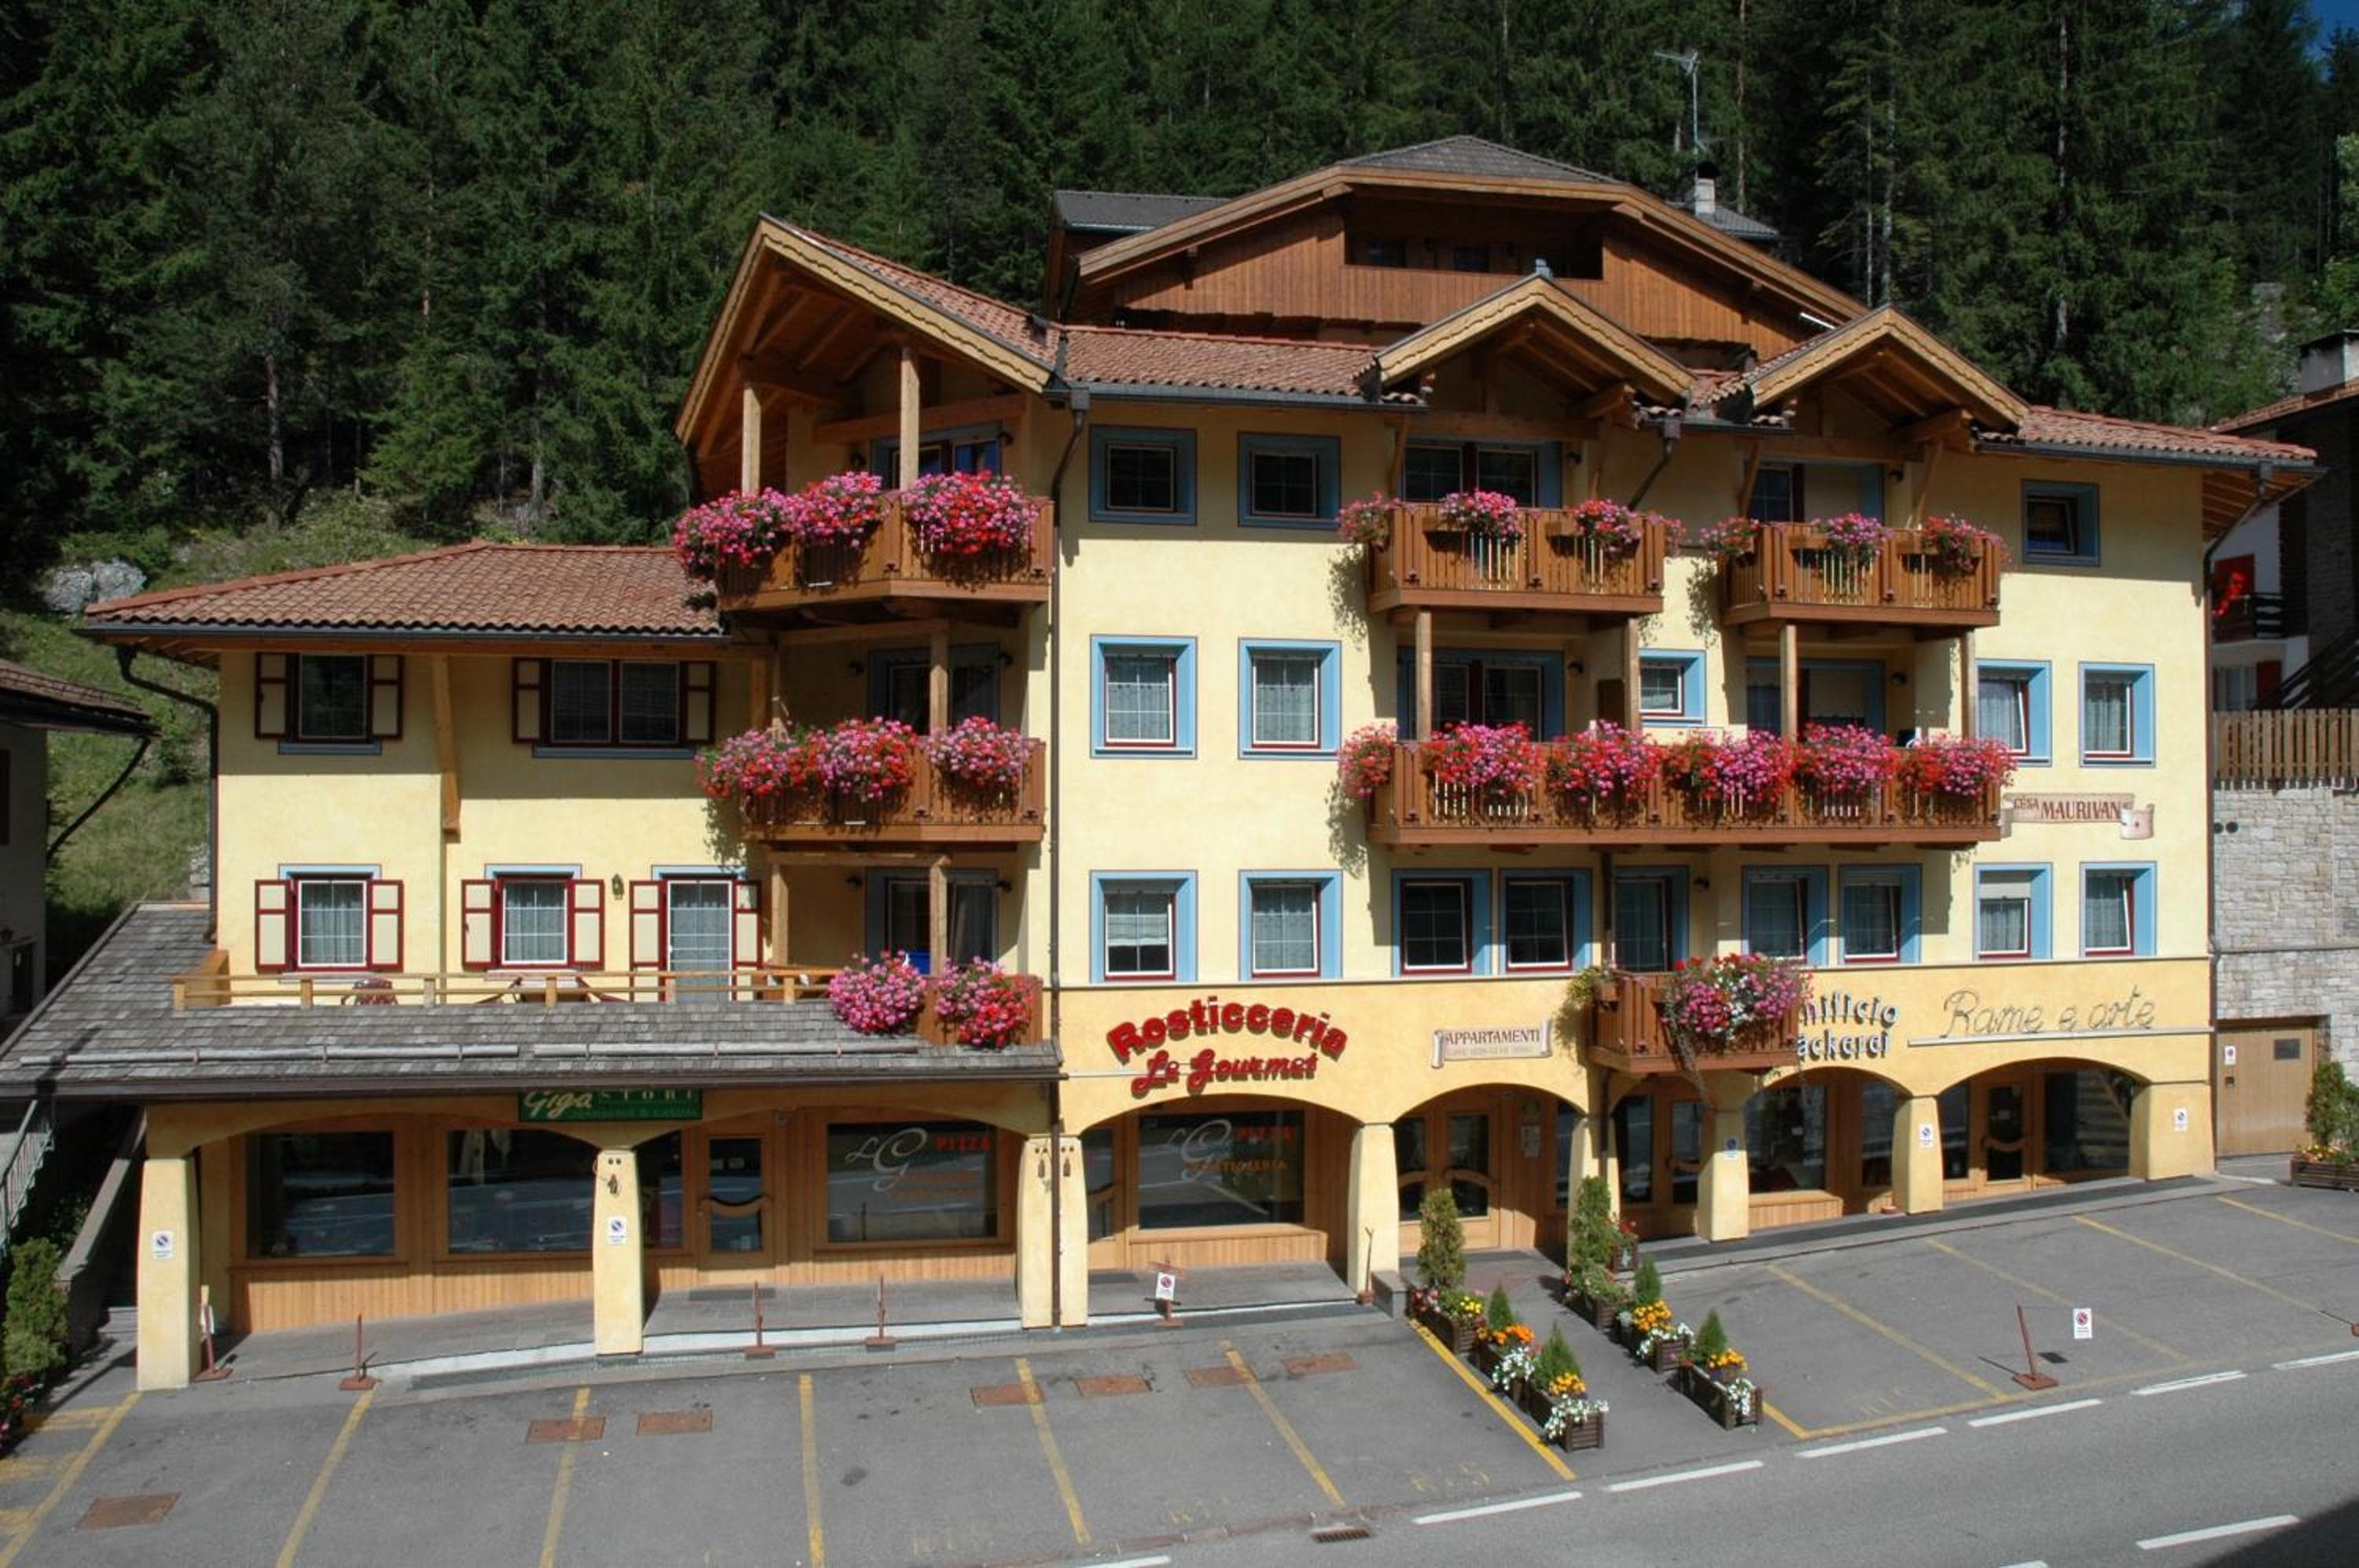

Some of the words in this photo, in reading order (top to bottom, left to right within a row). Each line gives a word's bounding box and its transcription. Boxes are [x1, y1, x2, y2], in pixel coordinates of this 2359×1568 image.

[2040, 800, 2122, 820] MAURIVAN
[1106, 996, 1349, 1066] Rosticceria
[1801, 991, 1901, 1029] nificio
[1938, 987, 2044, 1038] Rame
[2059, 1004, 2077, 1032] e
[1445, 1029, 1540, 1045] APPARTAMENTI
[1131, 1050, 1180, 1099] Le
[1186, 1048, 1319, 1096] Gourmet
